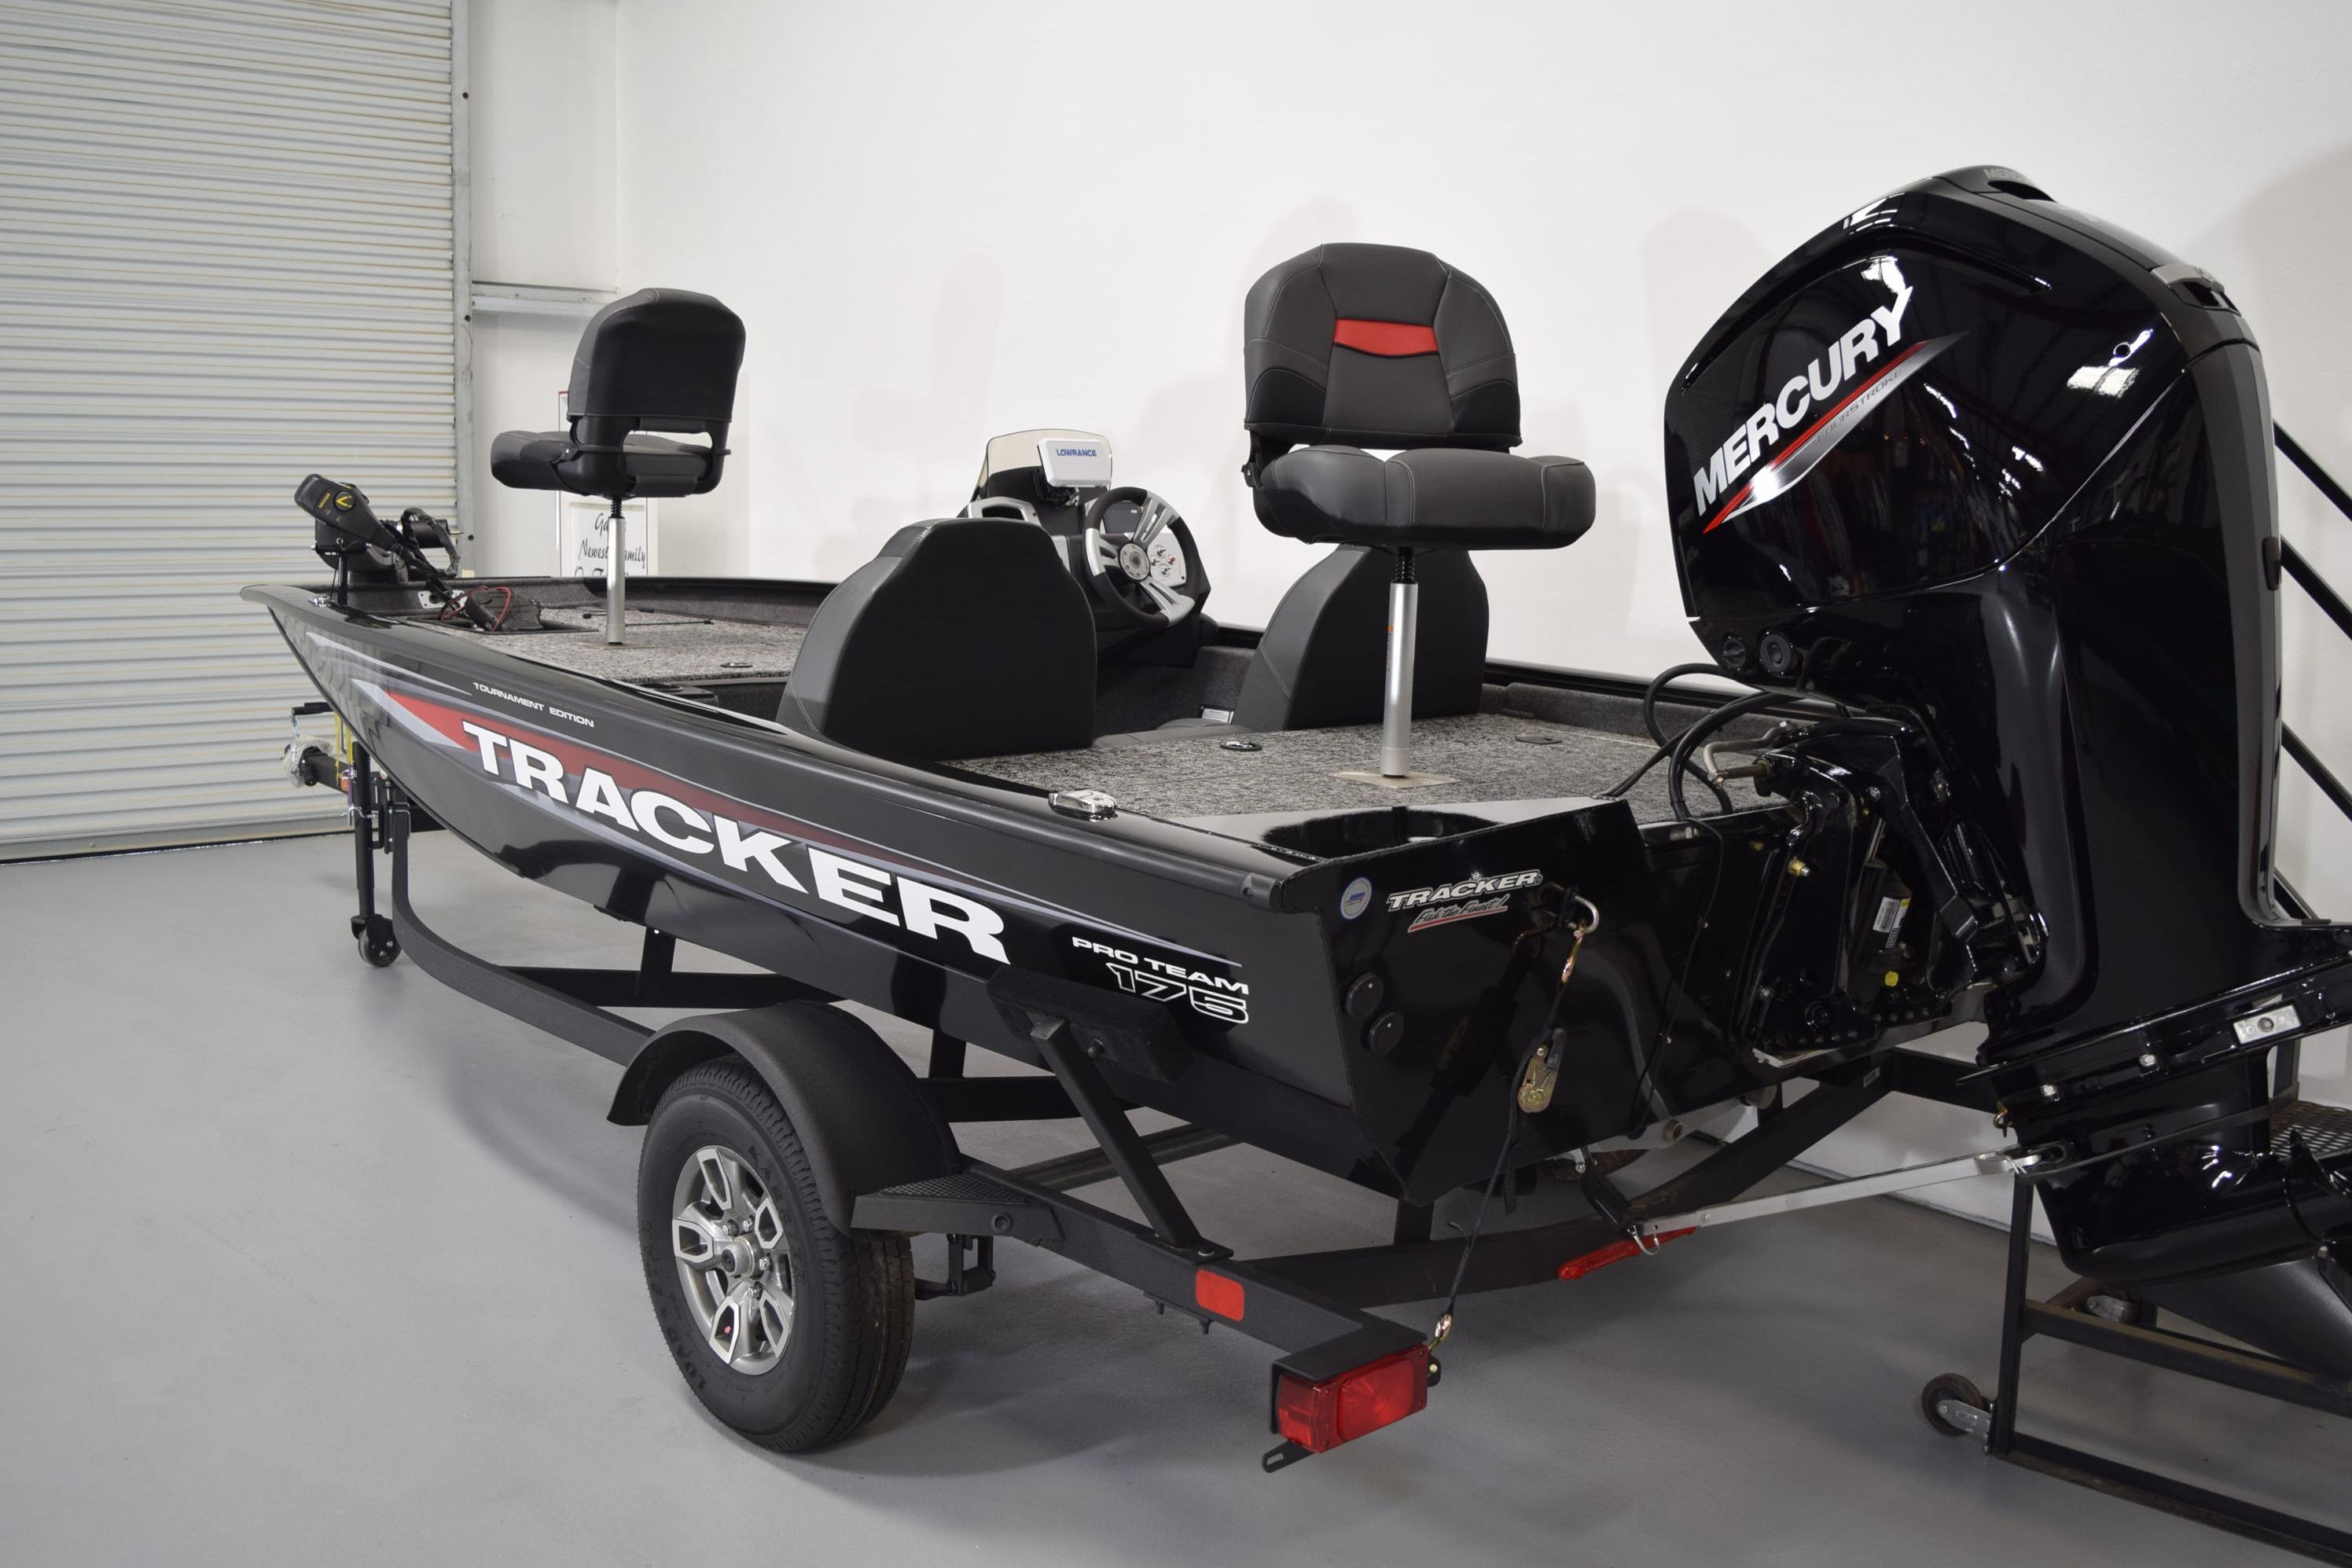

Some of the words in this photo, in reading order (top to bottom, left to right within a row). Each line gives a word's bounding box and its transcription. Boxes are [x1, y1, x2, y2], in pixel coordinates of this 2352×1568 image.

[1693, 286, 1913, 516] MERCURY
[1815, 367, 1902, 442] FOURSTROKE
[1056, 448, 1097, 457] LOWRANCE
[624, 546, 645, 570] amily
[472, 681, 544, 711] TOURNAMENT
[549, 707, 595, 729] EDITION
[462, 720, 1012, 965] TRACKER
[1386, 869, 1542, 911] TRACKER
[1072, 936, 1139, 964] PRO
[1144, 957, 1249, 995] TEAM
[1105, 962, 1249, 1024] 175
